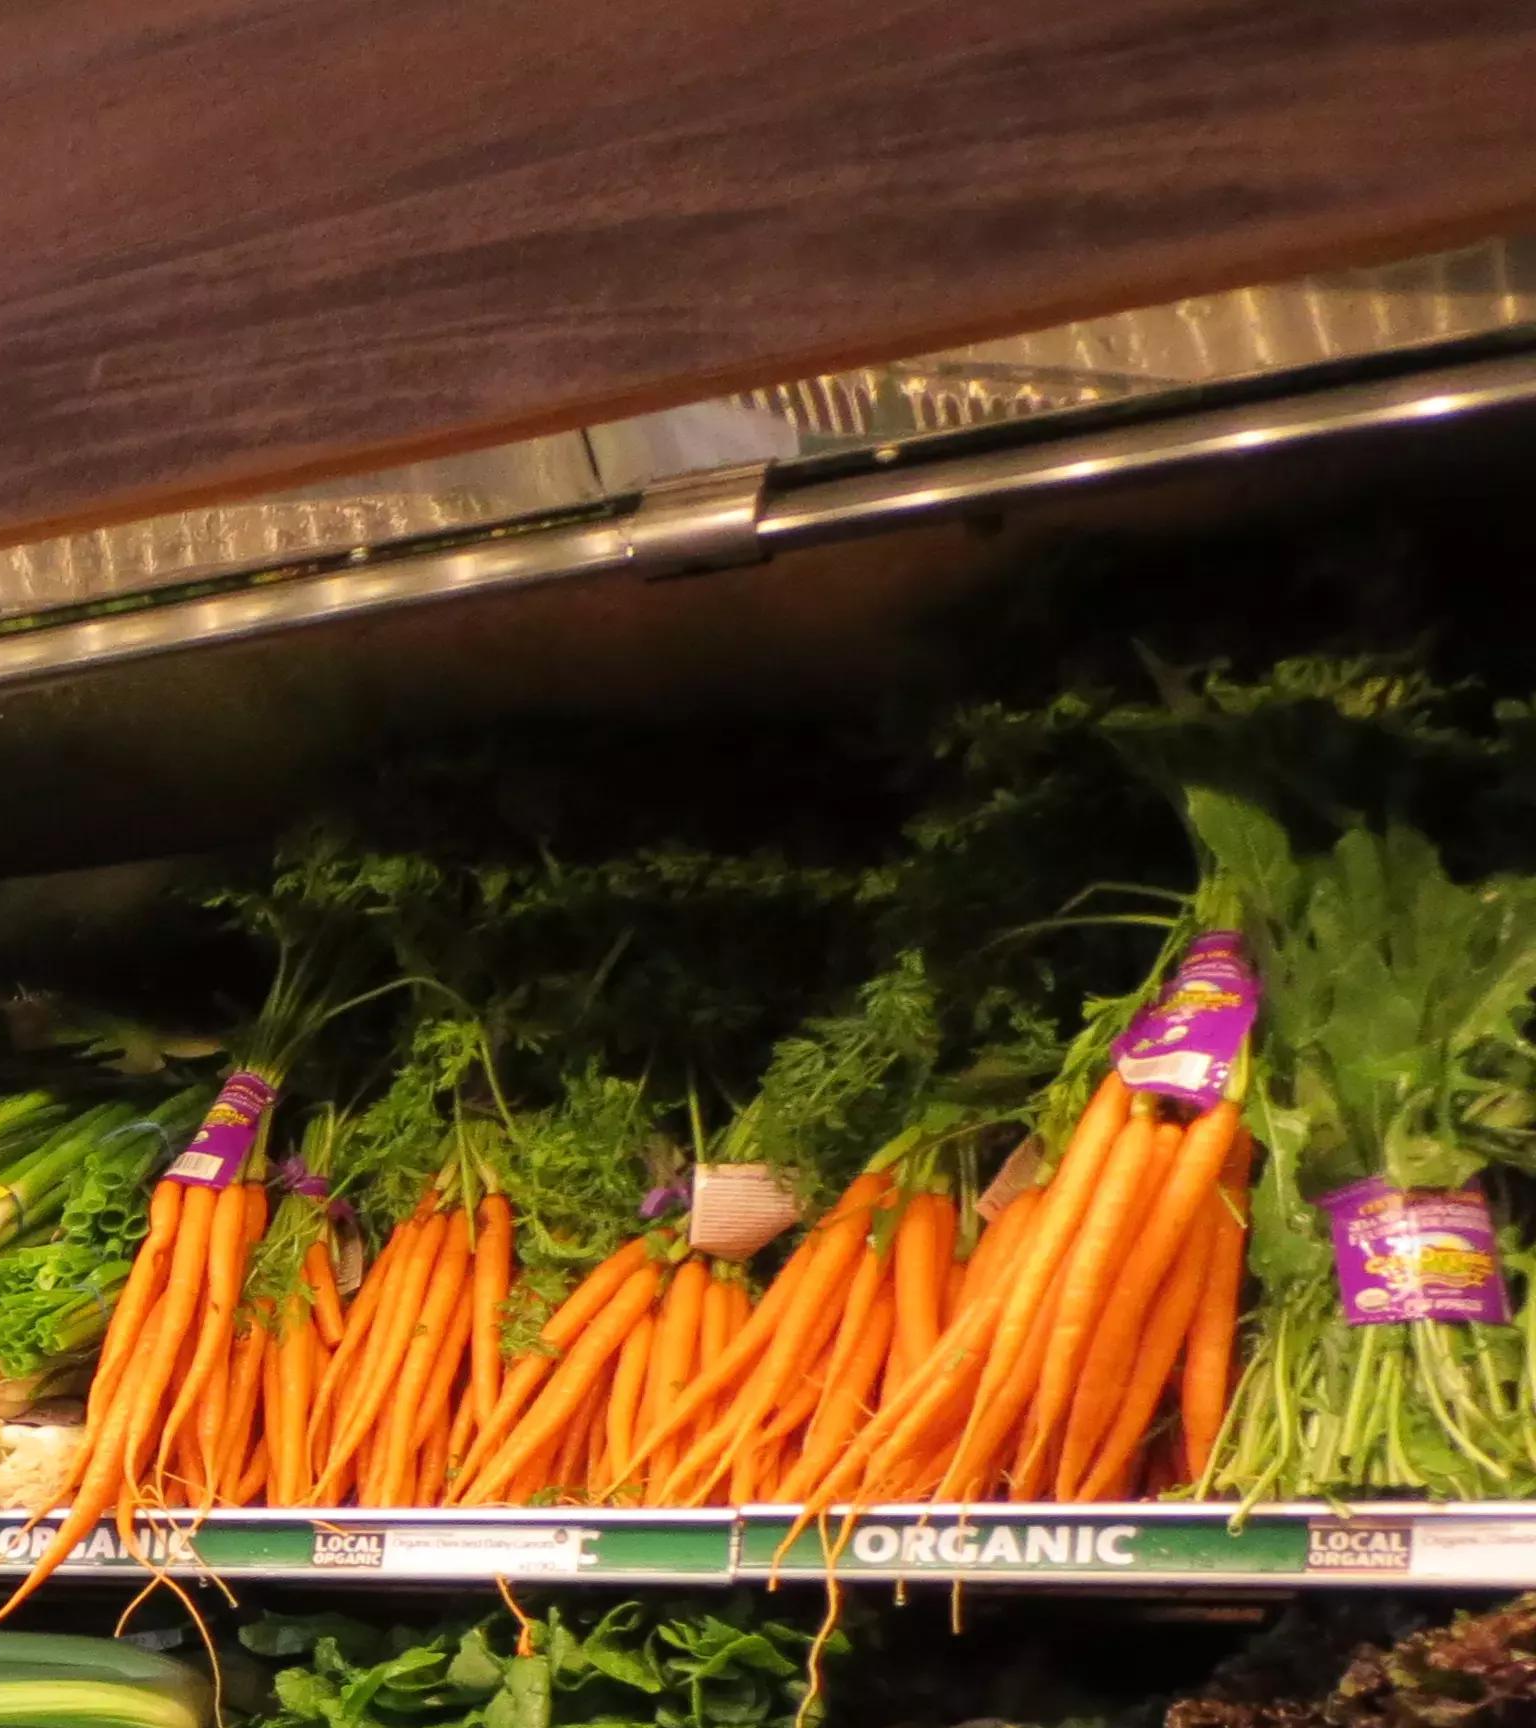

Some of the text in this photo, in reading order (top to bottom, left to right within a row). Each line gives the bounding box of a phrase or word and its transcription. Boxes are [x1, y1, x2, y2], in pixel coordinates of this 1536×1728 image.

[315, 1533, 382, 1552] LOCAL
[853, 1525, 1136, 1566] ORGANIC
[1310, 1529, 1408, 1552] LOCAL
[313, 1551, 382, 1567] ORGANIC
[1308, 1551, 1408, 1568] ORGANIC
